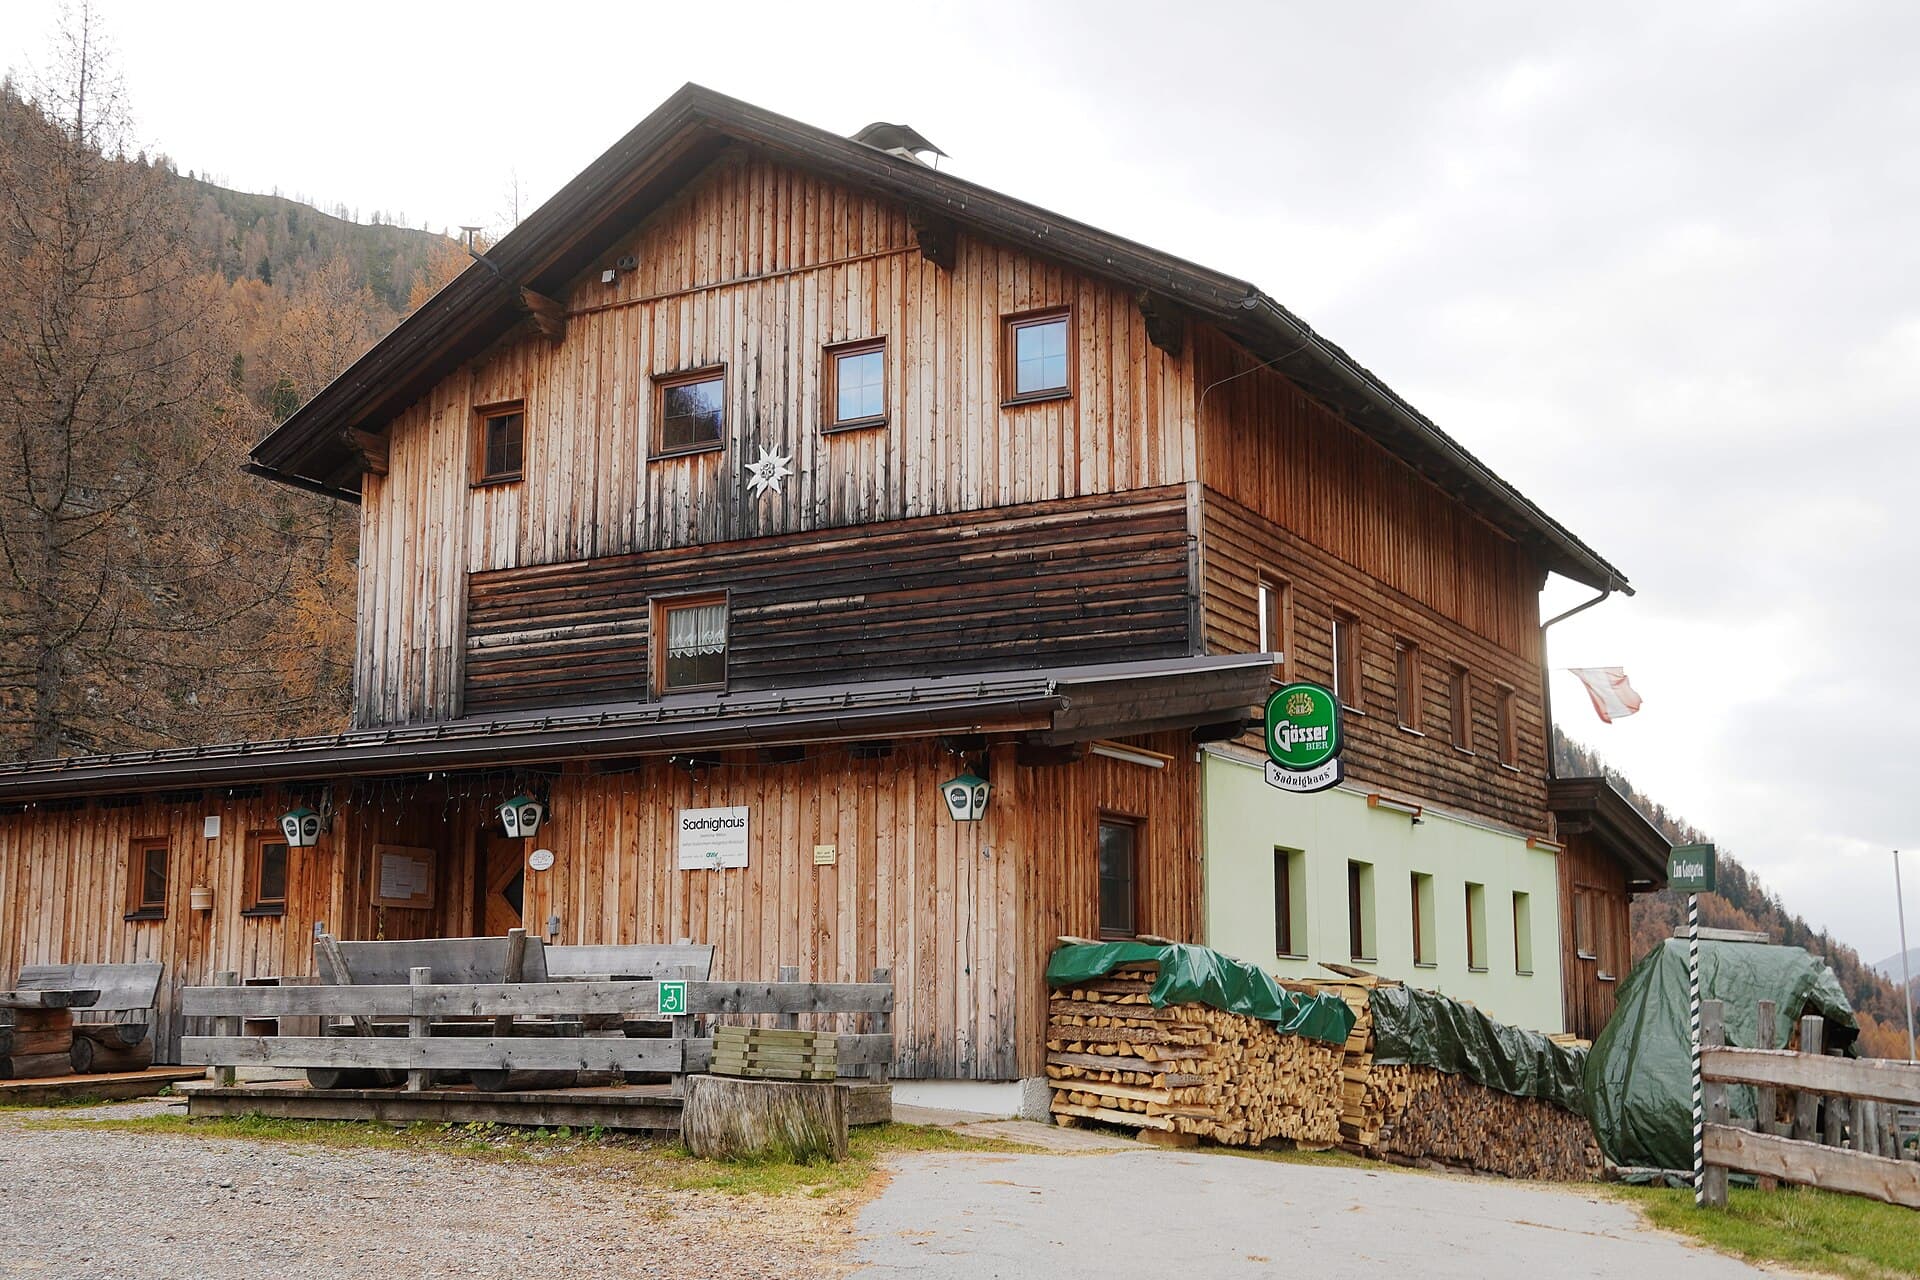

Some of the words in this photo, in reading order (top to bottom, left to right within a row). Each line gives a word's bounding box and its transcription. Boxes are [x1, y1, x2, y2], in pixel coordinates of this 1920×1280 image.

[1274, 720, 1329, 752] Gösser
[1306, 741, 1328, 751] BIER
[682, 816, 745, 832] Sadnighaus
